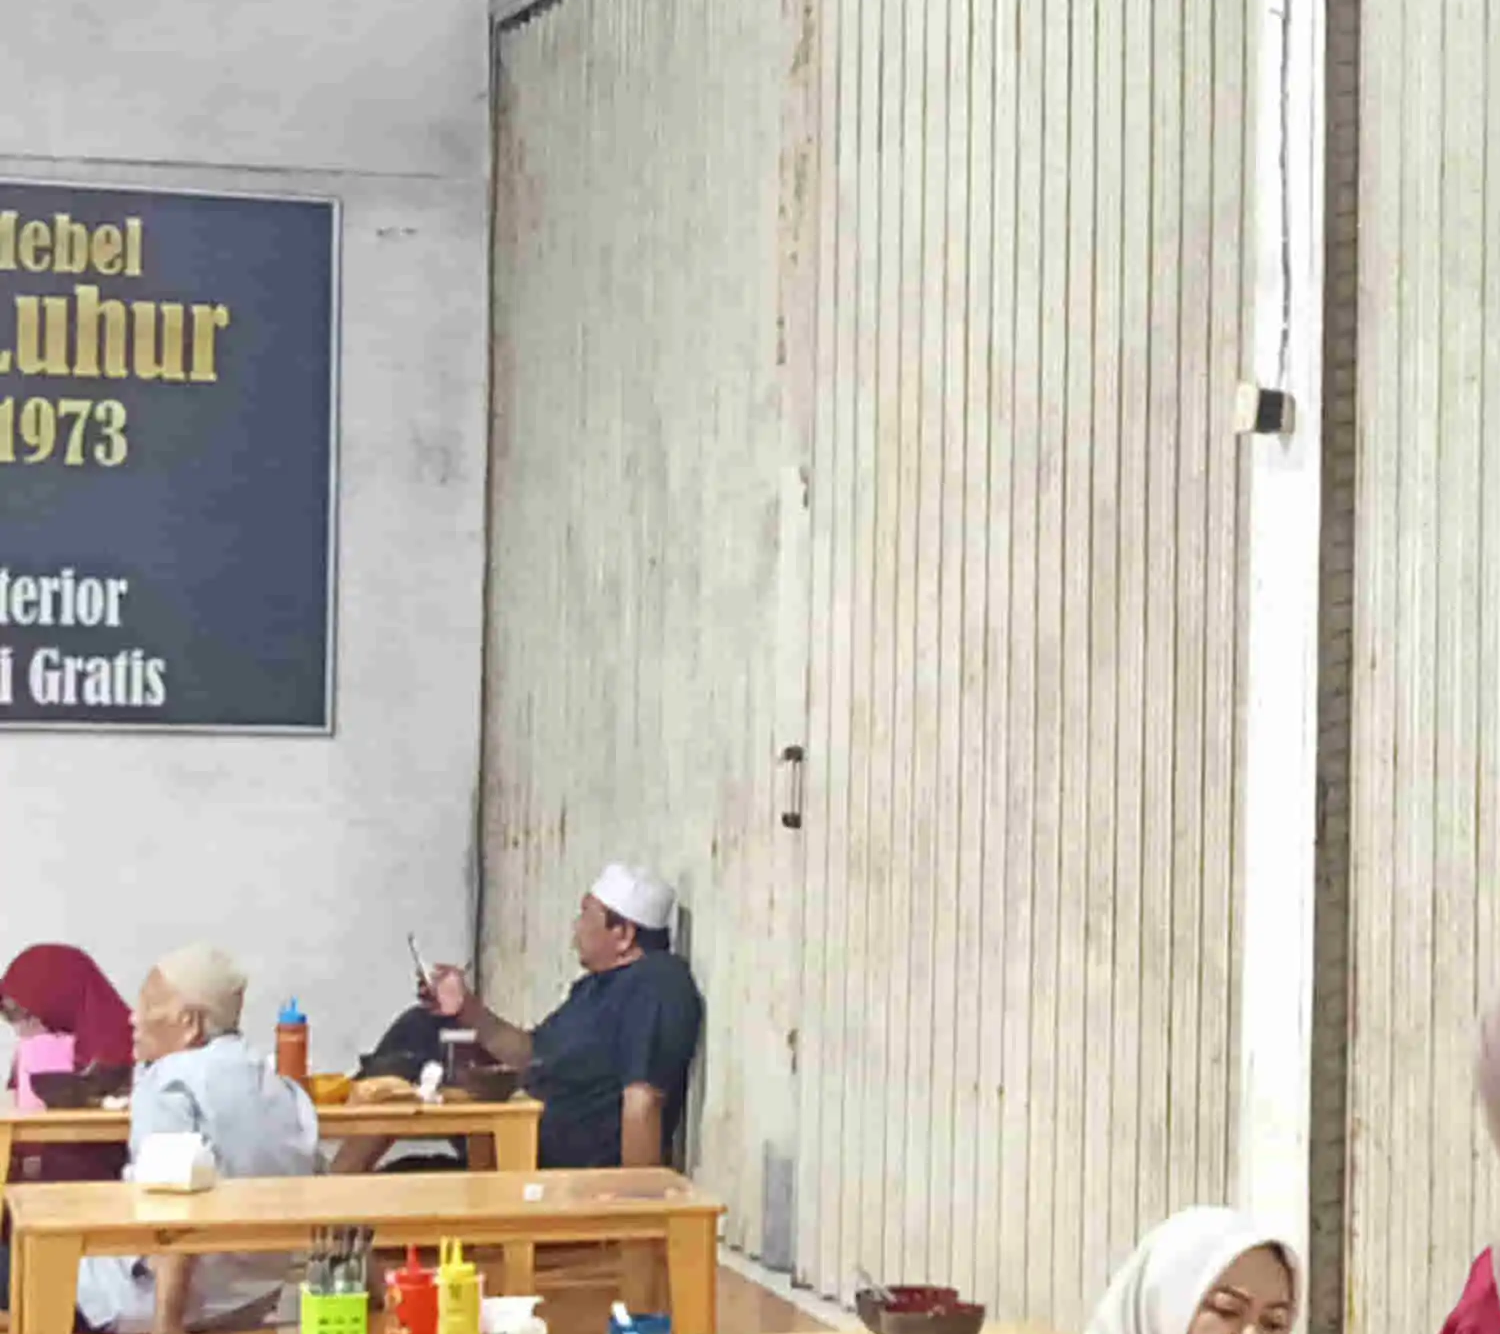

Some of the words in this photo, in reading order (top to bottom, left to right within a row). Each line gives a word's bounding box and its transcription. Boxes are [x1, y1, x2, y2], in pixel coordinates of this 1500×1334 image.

[0, 284, 230, 382] uhur
[0, 396, 128, 466] 1973
[29, 646, 167, 707] Gratis
